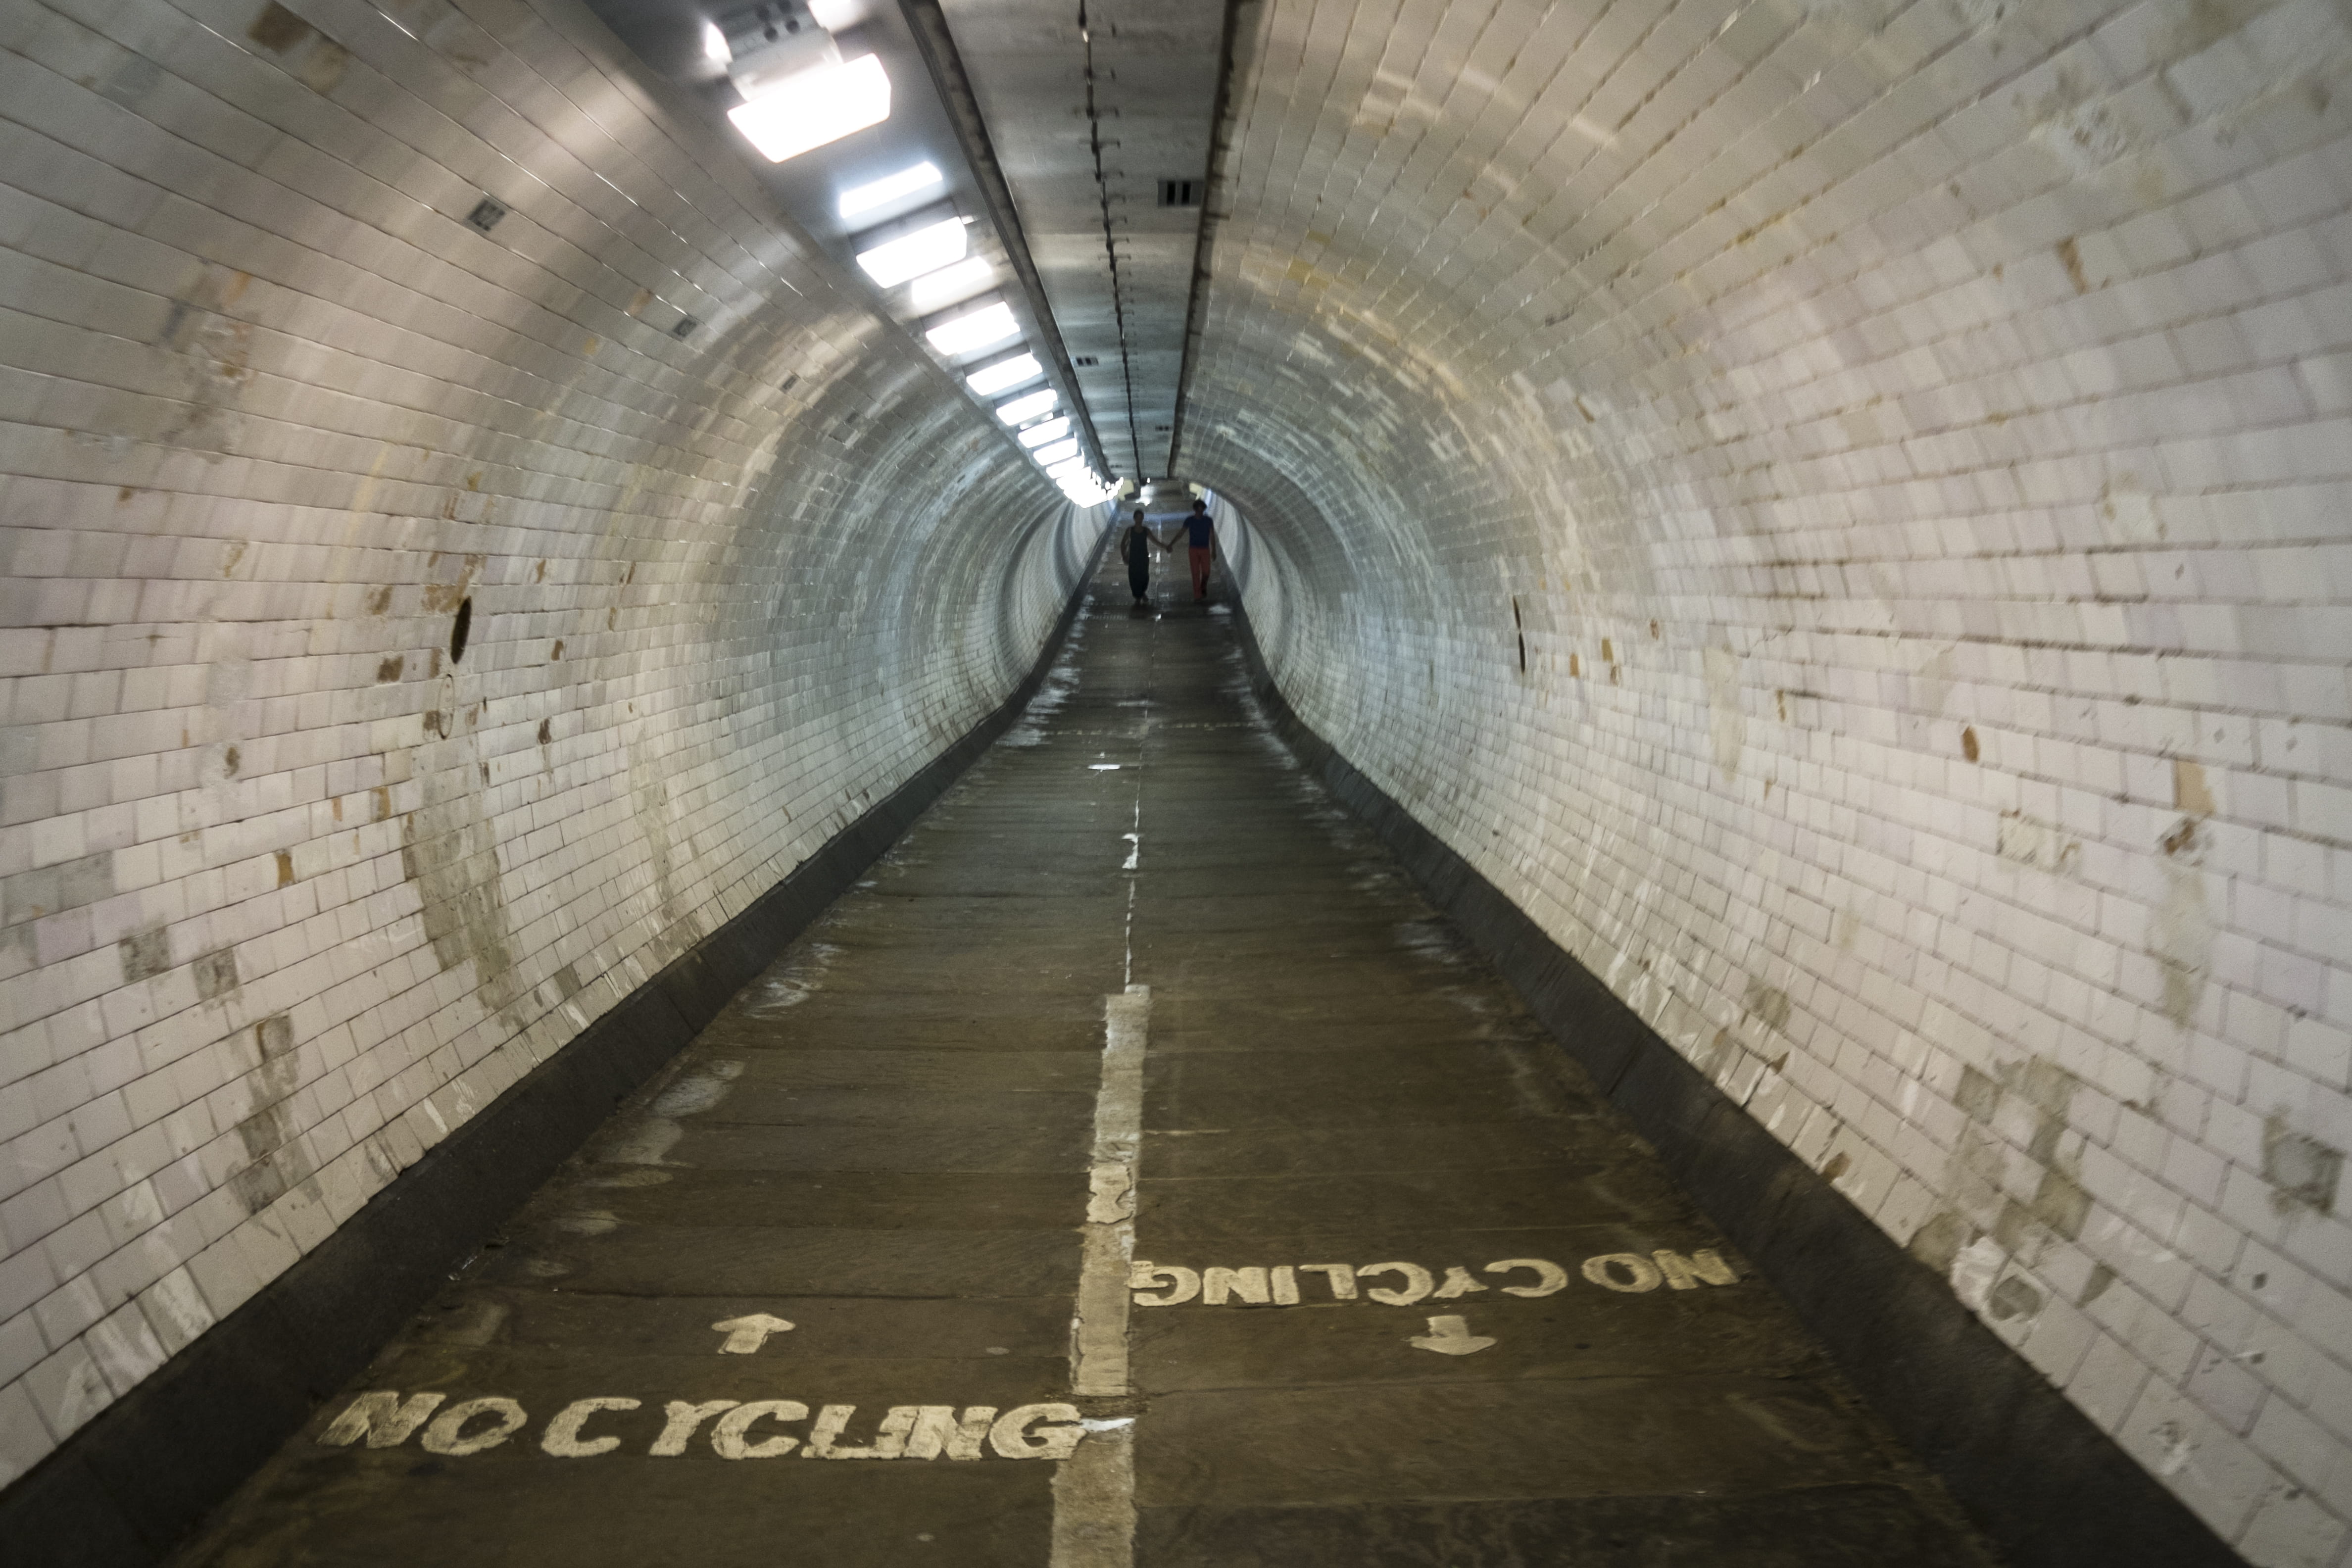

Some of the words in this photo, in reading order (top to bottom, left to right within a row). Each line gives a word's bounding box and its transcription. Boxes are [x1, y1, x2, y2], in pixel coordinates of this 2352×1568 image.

[1127, 1258, 1568, 1307] CYCLING
[1581, 1249, 1740, 1293] NO
[316, 1391, 528, 1456] NO
[541, 1397, 1087, 1461] CYCLING
